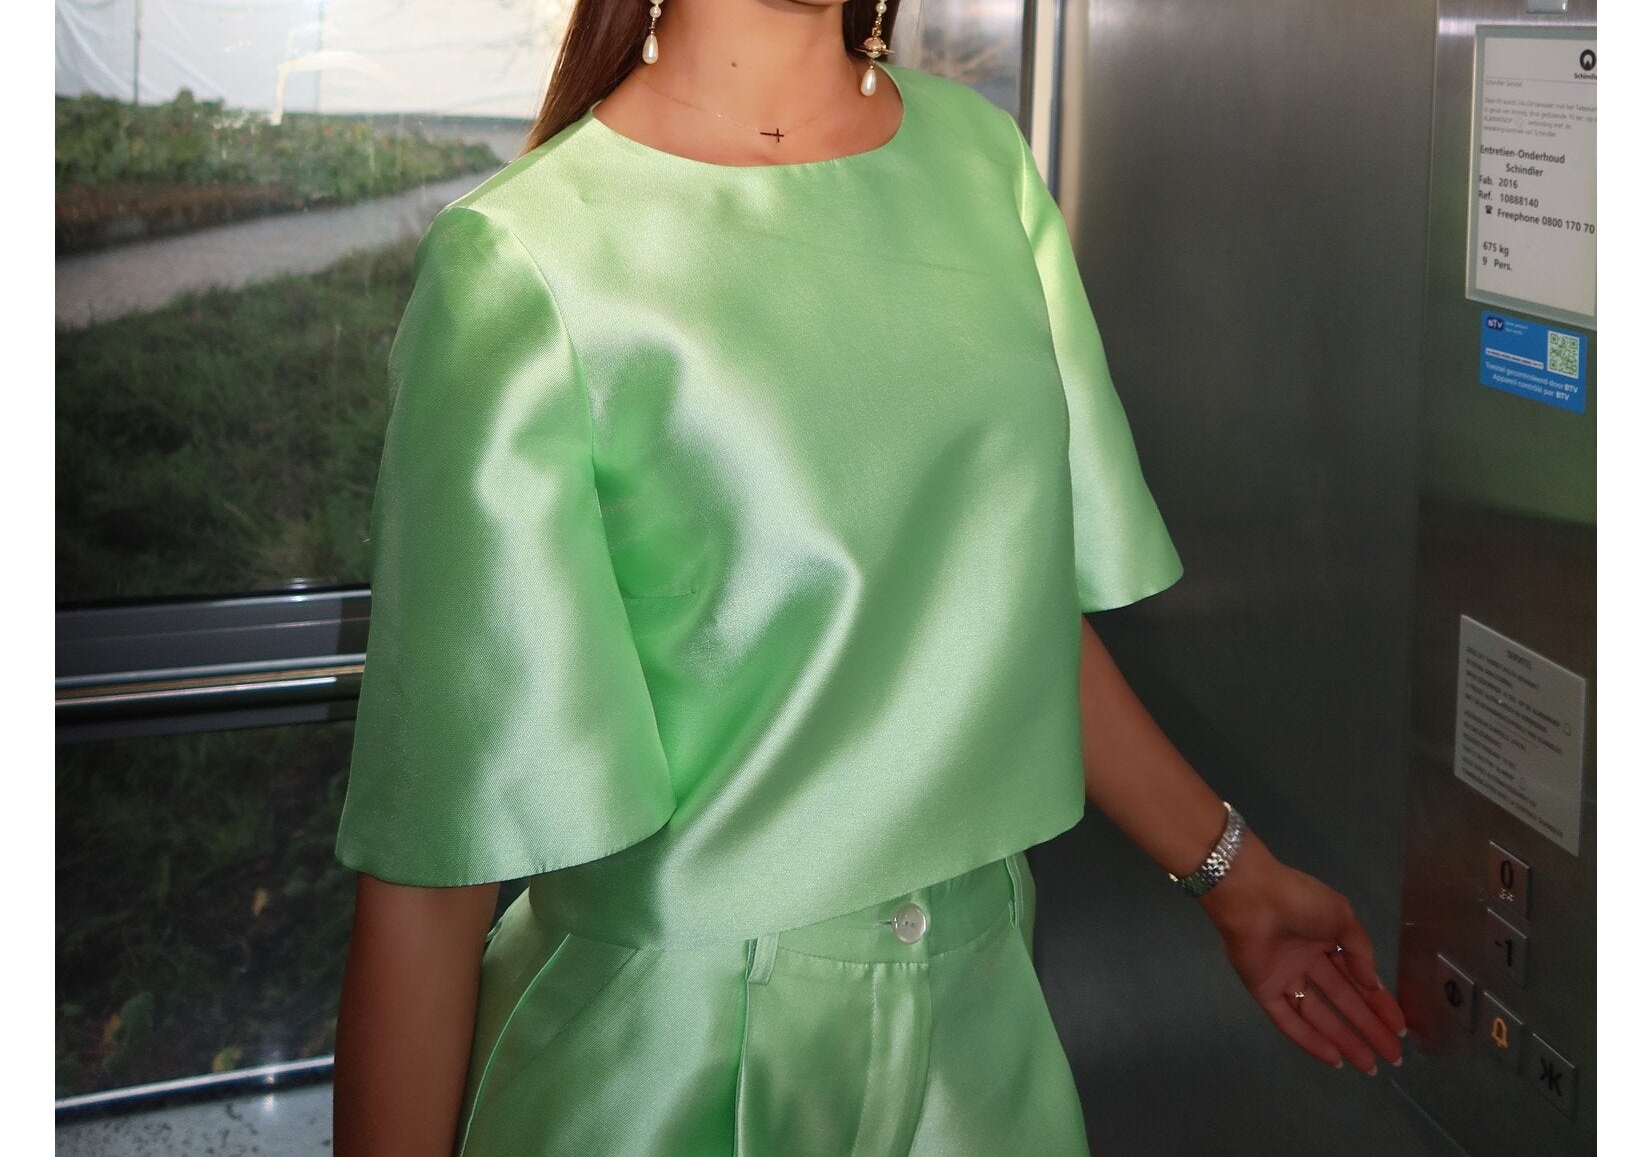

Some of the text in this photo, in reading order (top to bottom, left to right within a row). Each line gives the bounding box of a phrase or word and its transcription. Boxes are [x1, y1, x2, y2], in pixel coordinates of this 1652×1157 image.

[1480, 145, 1565, 164] Entretien-Onderhoud
[1506, 164, 1543, 177] Schindler
[1499, 178, 1518, 189] 2016
[1498, 208, 1595, 234] Freephone 0800 170 70
[1483, 242, 1509, 257] 675 kg
[1482, 257, 1513, 271] 9 Pers.
[1564, 384, 1578, 393] BTV
[1556, 391, 1569, 401] BTV
[1500, 859, 1513, 890] 0
